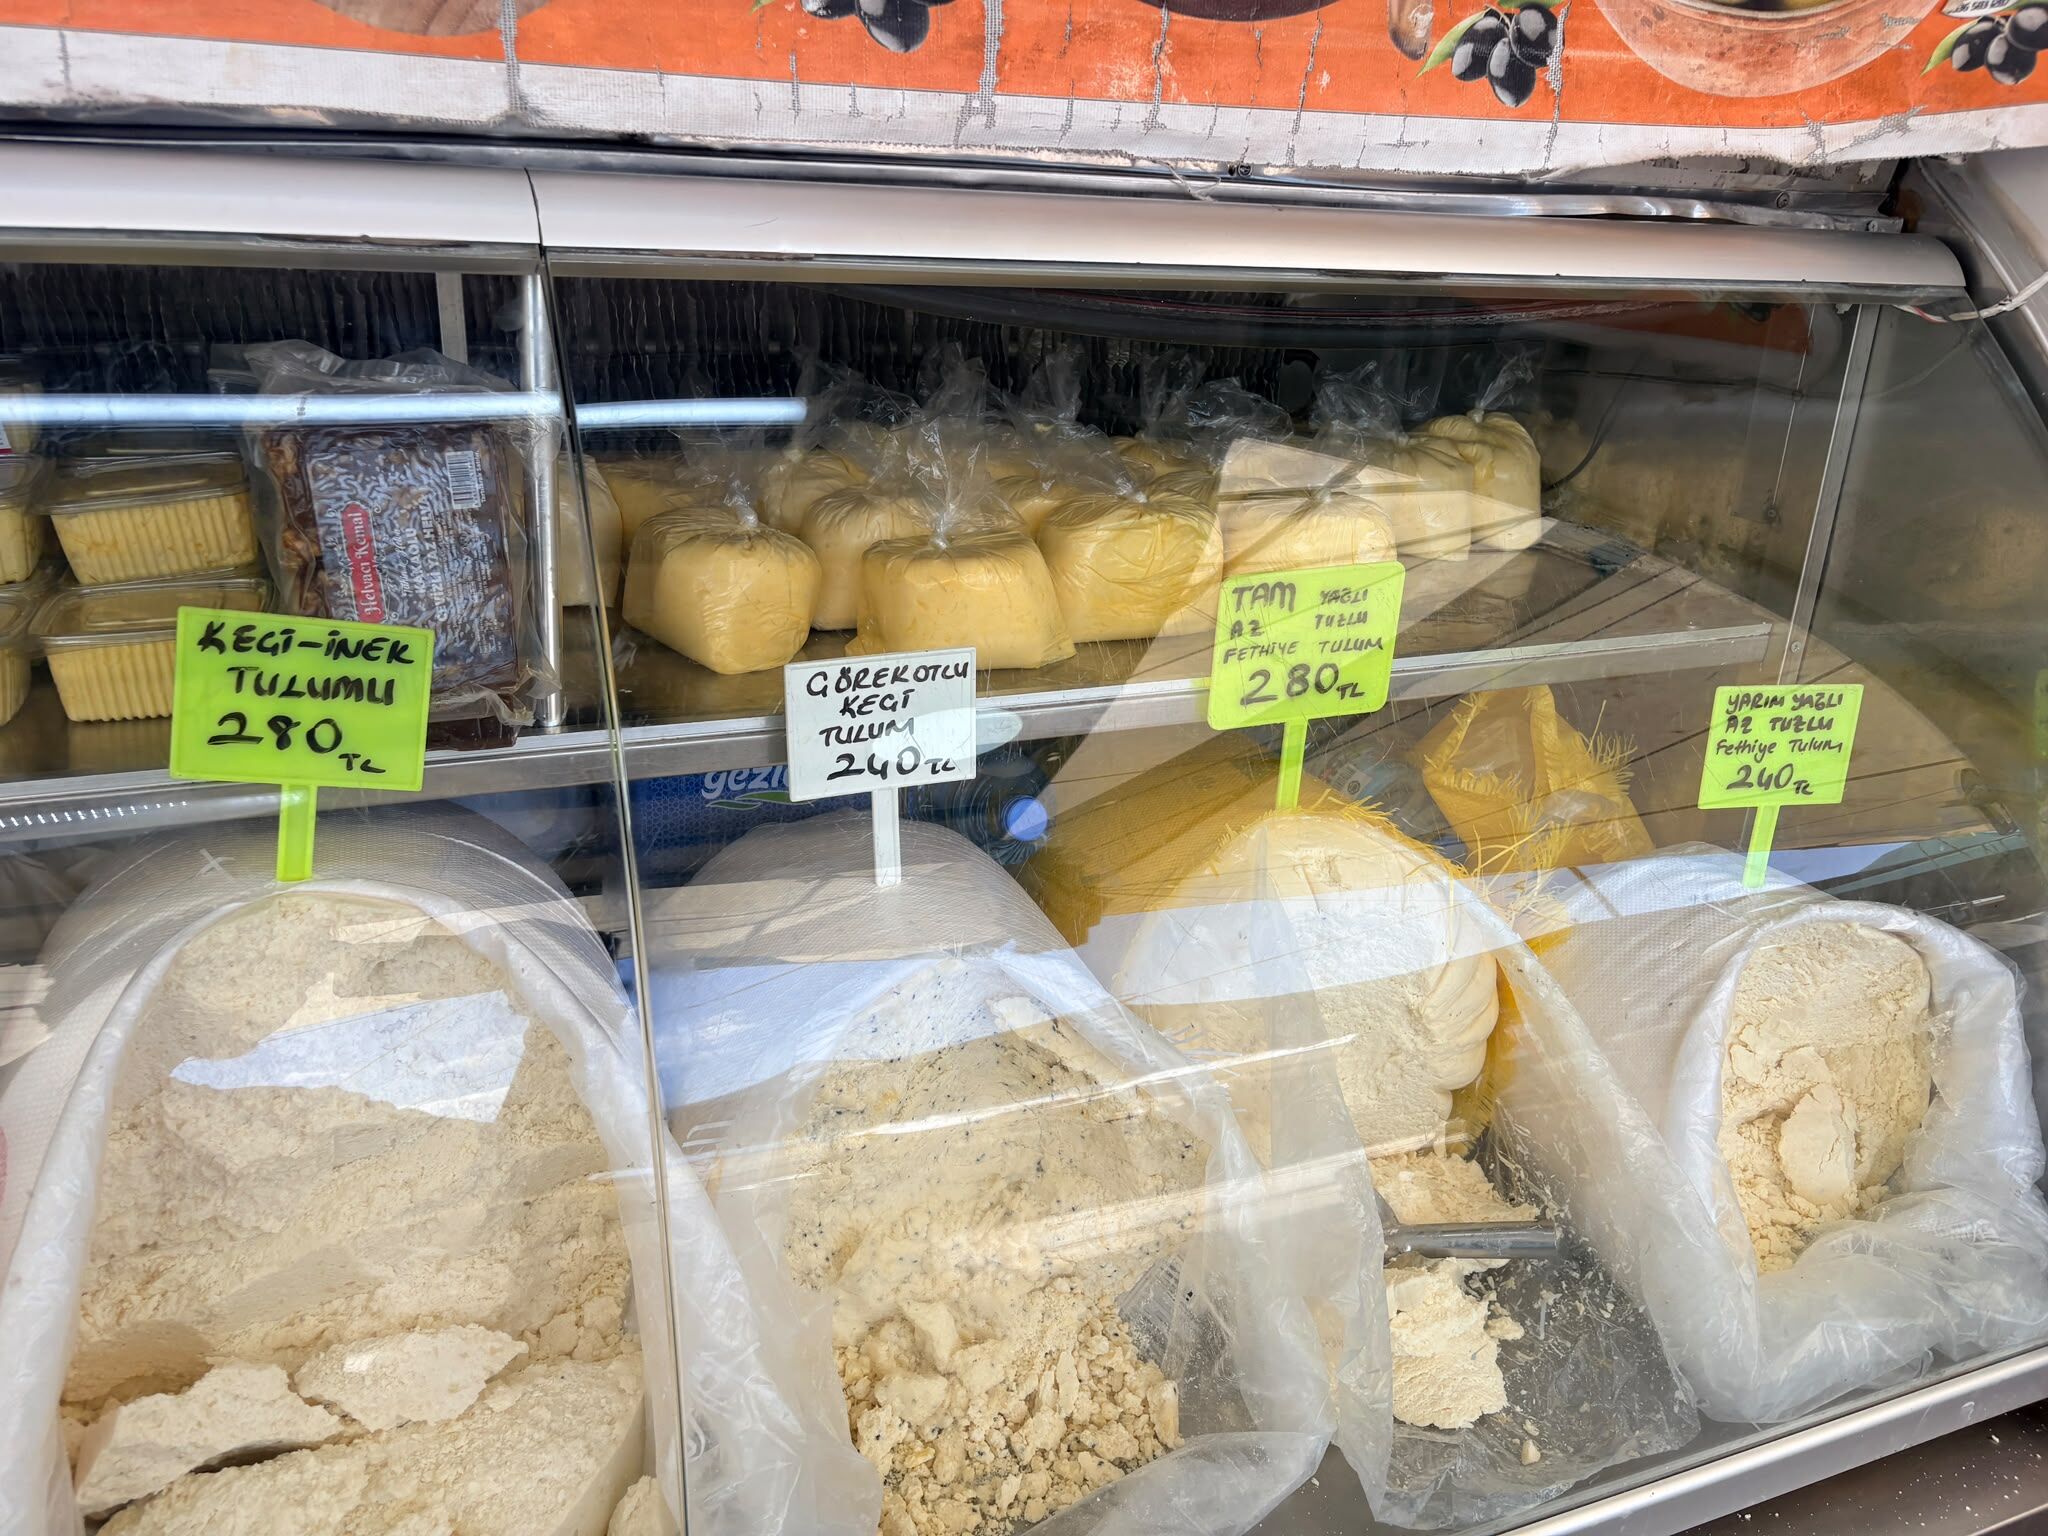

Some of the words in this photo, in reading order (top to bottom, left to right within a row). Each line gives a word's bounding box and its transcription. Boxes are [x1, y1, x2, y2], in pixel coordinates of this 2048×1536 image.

[347, 512, 369, 559] Kemal
[405, 528, 426, 595] KAKAOLU
[425, 542, 440, 569] YAZ
[360, 562, 381, 615] Helvacı
[1232, 581, 1296, 613] TAM
[1230, 619, 1264, 640] AZ
[1315, 611, 1368, 630] TUZLU
[1318, 637, 1384, 655] TULUM
[227, 666, 395, 705] TULUMU
[1240, 663, 1339, 706] 280
[1725, 692, 1785, 714] YARIM
[207, 712, 343, 754] 280
[819, 717, 914, 747] TULUM
[1725, 715, 1753, 734] AZ
[1769, 716, 1834, 733] TUZLU
[826, 746, 921, 780] 240
[1716, 738, 1777, 763] Fethiye
[1726, 763, 1794, 790] 240
